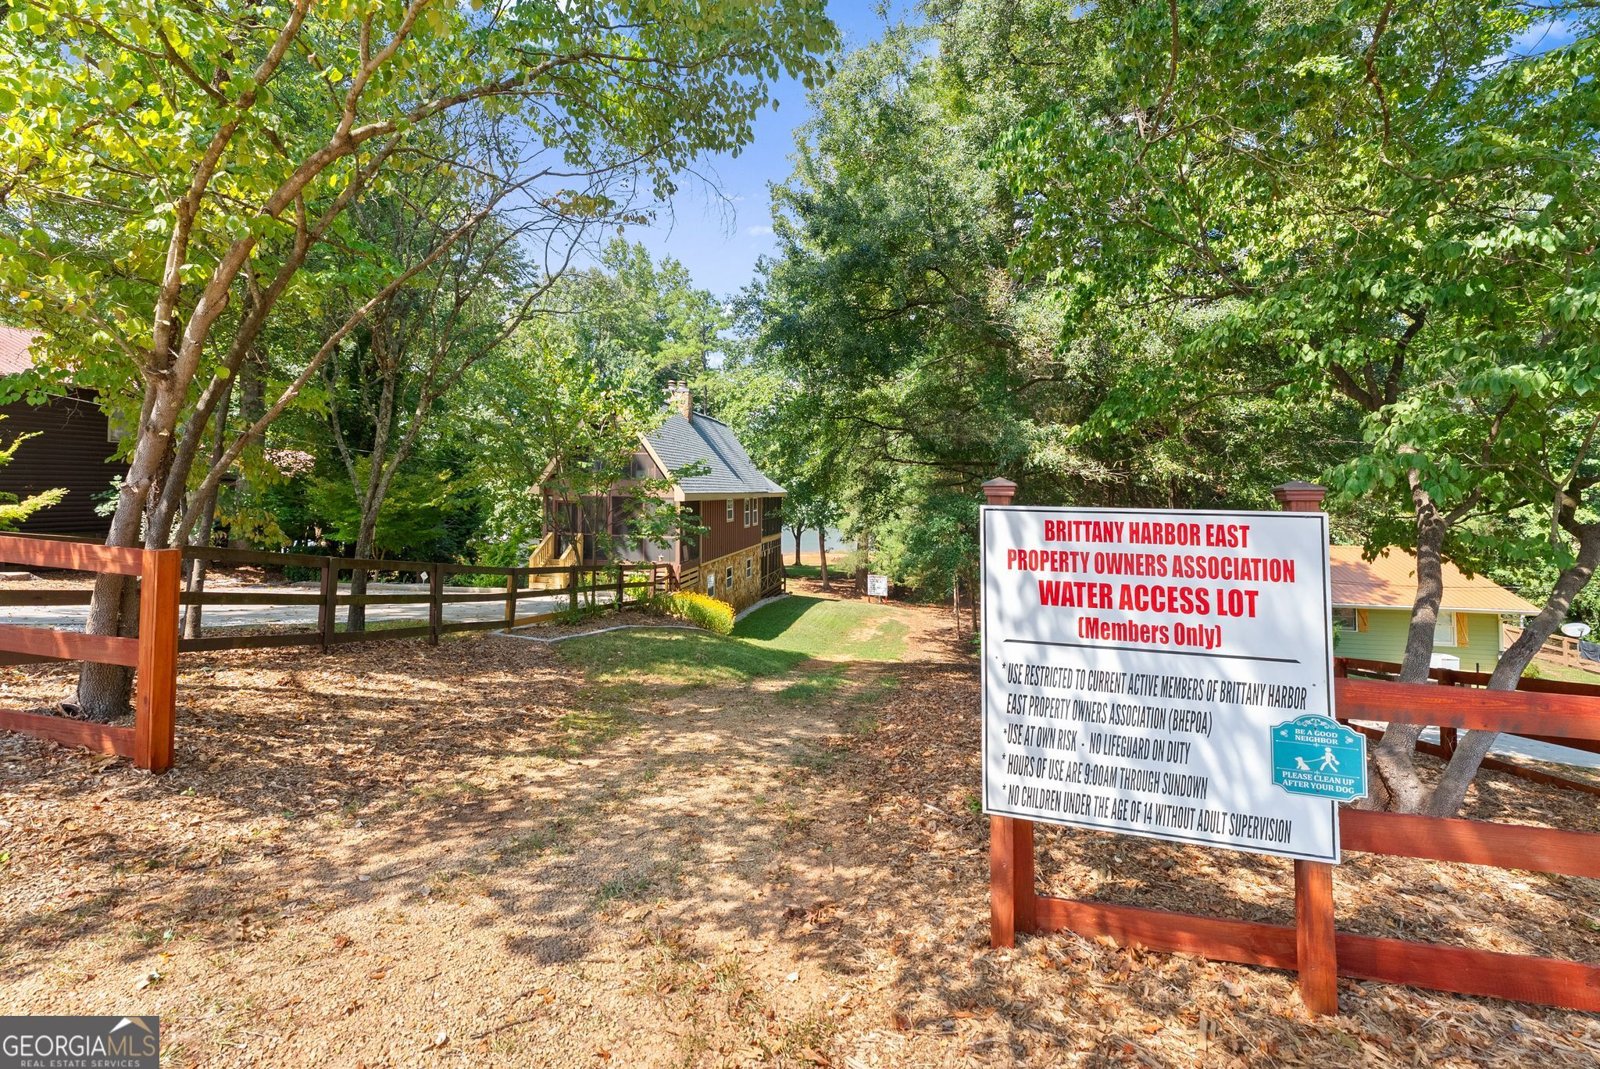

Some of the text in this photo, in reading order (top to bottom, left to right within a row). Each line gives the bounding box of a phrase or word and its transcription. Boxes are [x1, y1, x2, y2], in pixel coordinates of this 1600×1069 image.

[1044, 520, 1250, 548] BRITTANY HARBOR EAST
[1008, 549, 1295, 583] PROPERTY OWNERS ASSOCIATION
[1038, 580, 1258, 618] WATER ACCESS LOT
[1078, 616, 1222, 650] (Members Only)
[1008, 663, 1307, 710] USE RESTRICTED TO CURRENT ACTIVE MEMBERS OF BRITTANY HARBOR
[1006, 693, 1212, 738] EAST PROPERTY OWNERS ASSOCIATION (BHEPOA)
[1007, 724, 1023, 745] USE
[1024, 726, 1036, 746] AT
[1036, 727, 1056, 749] OWN
[1057, 729, 1078, 752] RISK
[1089, 732, 1100, 754] NO
[1102, 734, 1150, 760] LIFEGUARD
[1152, 739, 1164, 762] ON
[1166, 740, 1190, 764] DUTY
[1294, 734, 1338, 745] NEIGHBOR
[1314, 730, 1338, 738] GOOD
[1007, 754, 1208, 800] HOURS OF USE ARE 9:00AM THROUGH SUNDOWN
[1282, 770, 1354, 786] PLEASE CLEAN UP
[1282, 779, 1354, 794] AFTER YOUR DOG
[1008, 784, 1292, 844] NO CHILDREN UNDER THE AGE OF 14 WITHOUT ADULT SUPERVISION
